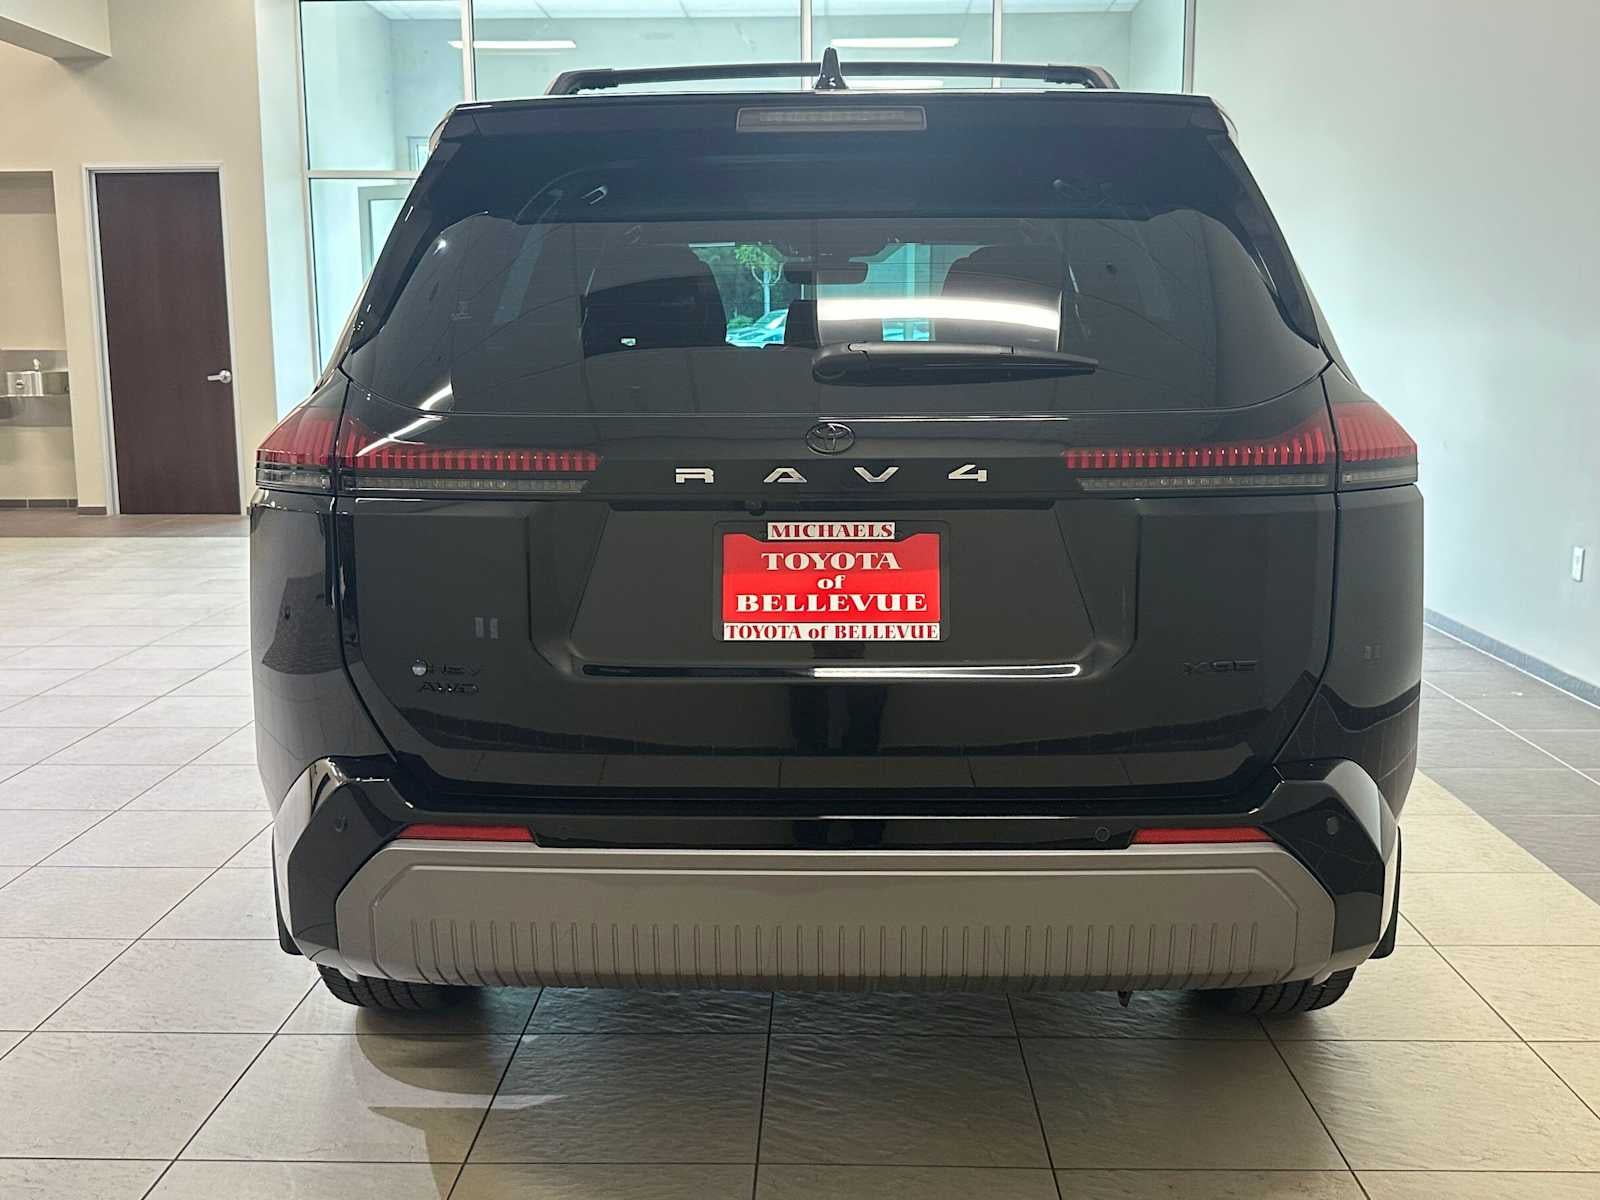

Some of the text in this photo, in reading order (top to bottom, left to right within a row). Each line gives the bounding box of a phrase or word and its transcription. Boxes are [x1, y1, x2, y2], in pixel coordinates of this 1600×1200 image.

[675, 464, 988, 484] RAV4
[771, 523, 893, 538] MICHAELS
[761, 552, 901, 570] TOYOTA
[817, 575, 846, 589] of
[736, 594, 927, 612] BELLEVUE
[725, 625, 938, 639] TOYOTA of BELLEVUE
